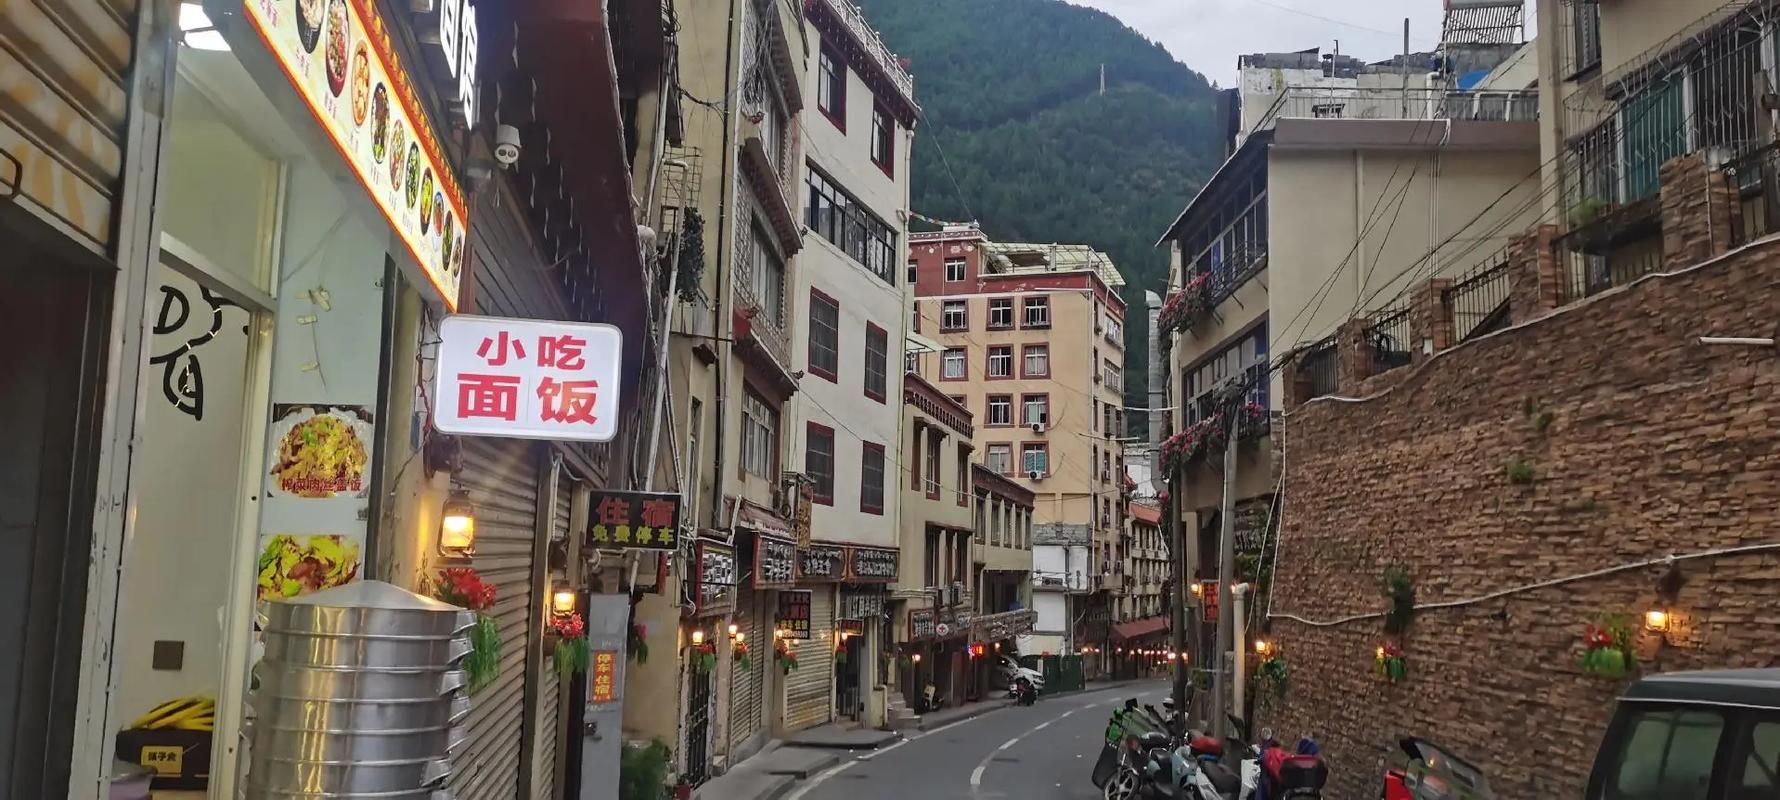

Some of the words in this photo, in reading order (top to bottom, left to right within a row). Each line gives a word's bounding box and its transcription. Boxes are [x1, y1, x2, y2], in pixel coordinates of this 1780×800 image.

[476, 331, 587, 371] 小吃
[457, 373, 599, 426] 面饭
[596, 496, 676, 528] 住宿
[592, 524, 675, 545] 免费停车
[595, 653, 612, 695] 停车住宿
